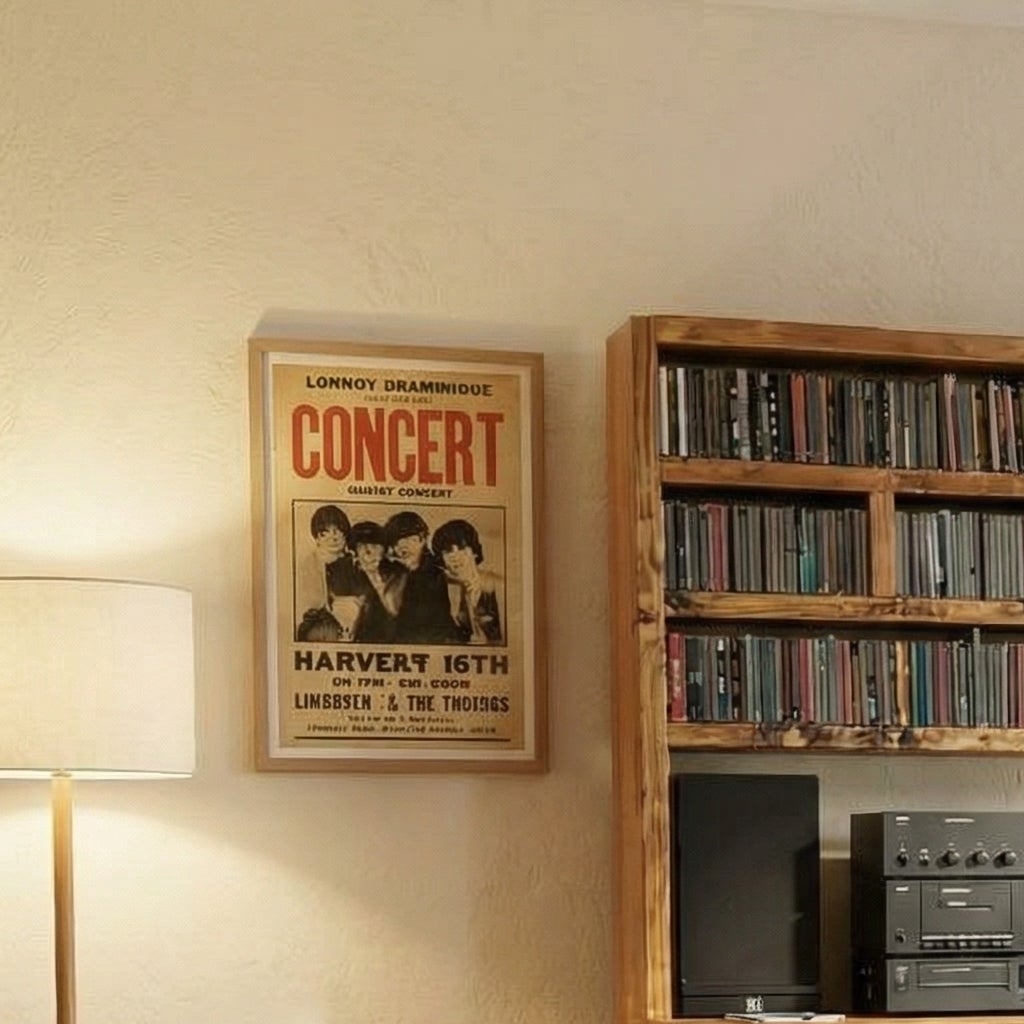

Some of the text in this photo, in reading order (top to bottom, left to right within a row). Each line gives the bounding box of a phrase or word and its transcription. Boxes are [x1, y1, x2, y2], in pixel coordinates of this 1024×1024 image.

[306, 375, 377, 391] LONNOY
[292, 403, 504, 487] CONCERT
[443, 654, 508, 674] 16TH
[407, 695, 435, 712] THE
